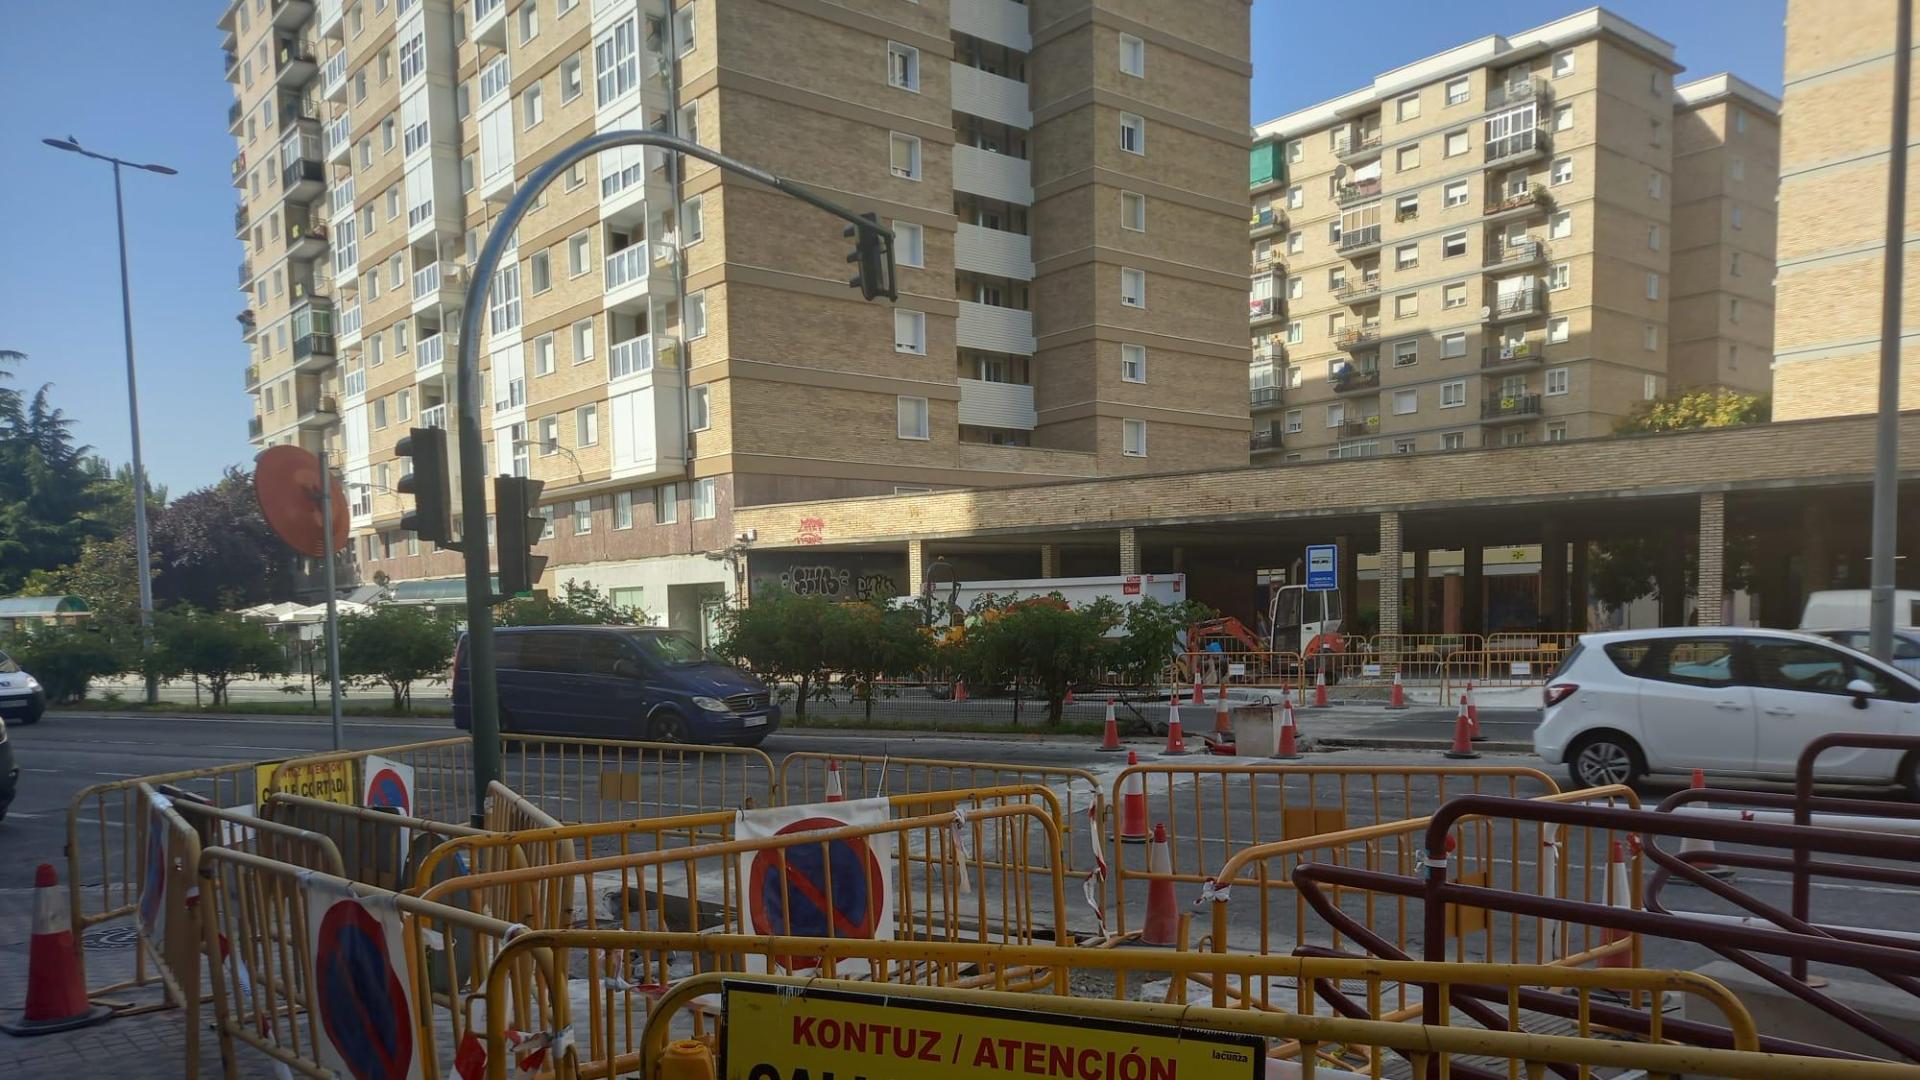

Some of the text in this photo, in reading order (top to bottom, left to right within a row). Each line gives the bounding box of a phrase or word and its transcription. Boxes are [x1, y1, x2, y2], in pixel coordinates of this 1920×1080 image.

[793, 1015, 1177, 1080] KONTUZ / ATENCIÓN
[1212, 1049, 1249, 1063] lacunza
